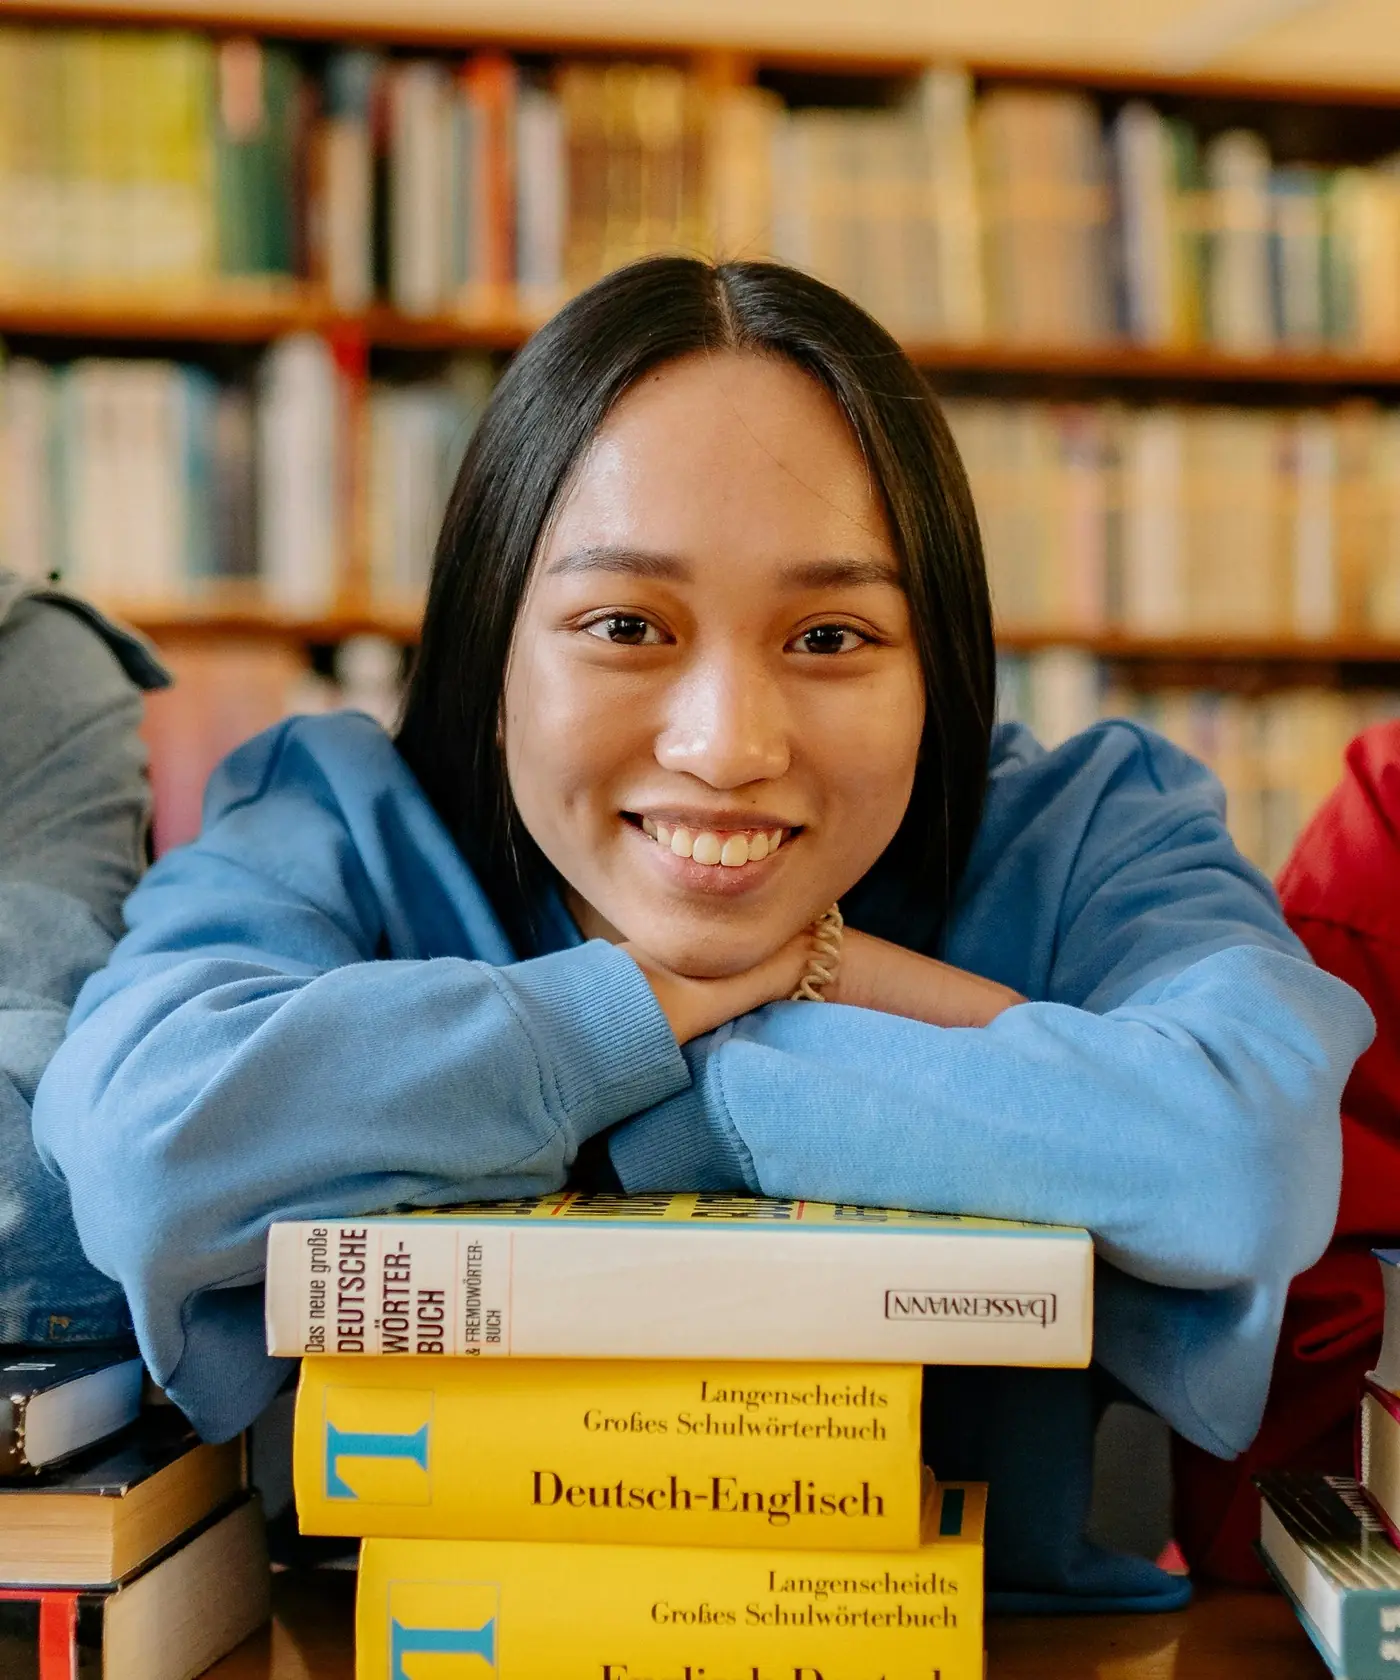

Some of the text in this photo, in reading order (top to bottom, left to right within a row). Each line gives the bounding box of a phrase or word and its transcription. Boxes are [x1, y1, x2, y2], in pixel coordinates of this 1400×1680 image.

[304, 1227, 332, 1354] Das neue große
[337, 1228, 368, 1354] DEUTSCHE
[374, 1241, 412, 1355] WÖRTER-
[462, 1239, 483, 1357] & FREMDWÖRTER-
[416, 1290, 445, 1355] BUCH
[485, 1309, 502, 1344] BUCH
[700, 1380, 889, 1410] Langenscheidts
[583, 1409, 887, 1441] Großes Schulwörterbuch
[532, 1470, 885, 1526] Deutsch-Englisch
[768, 1570, 959, 1600] Langenscheidts
[651, 1602, 959, 1629] Großes Schulwörterbuch
